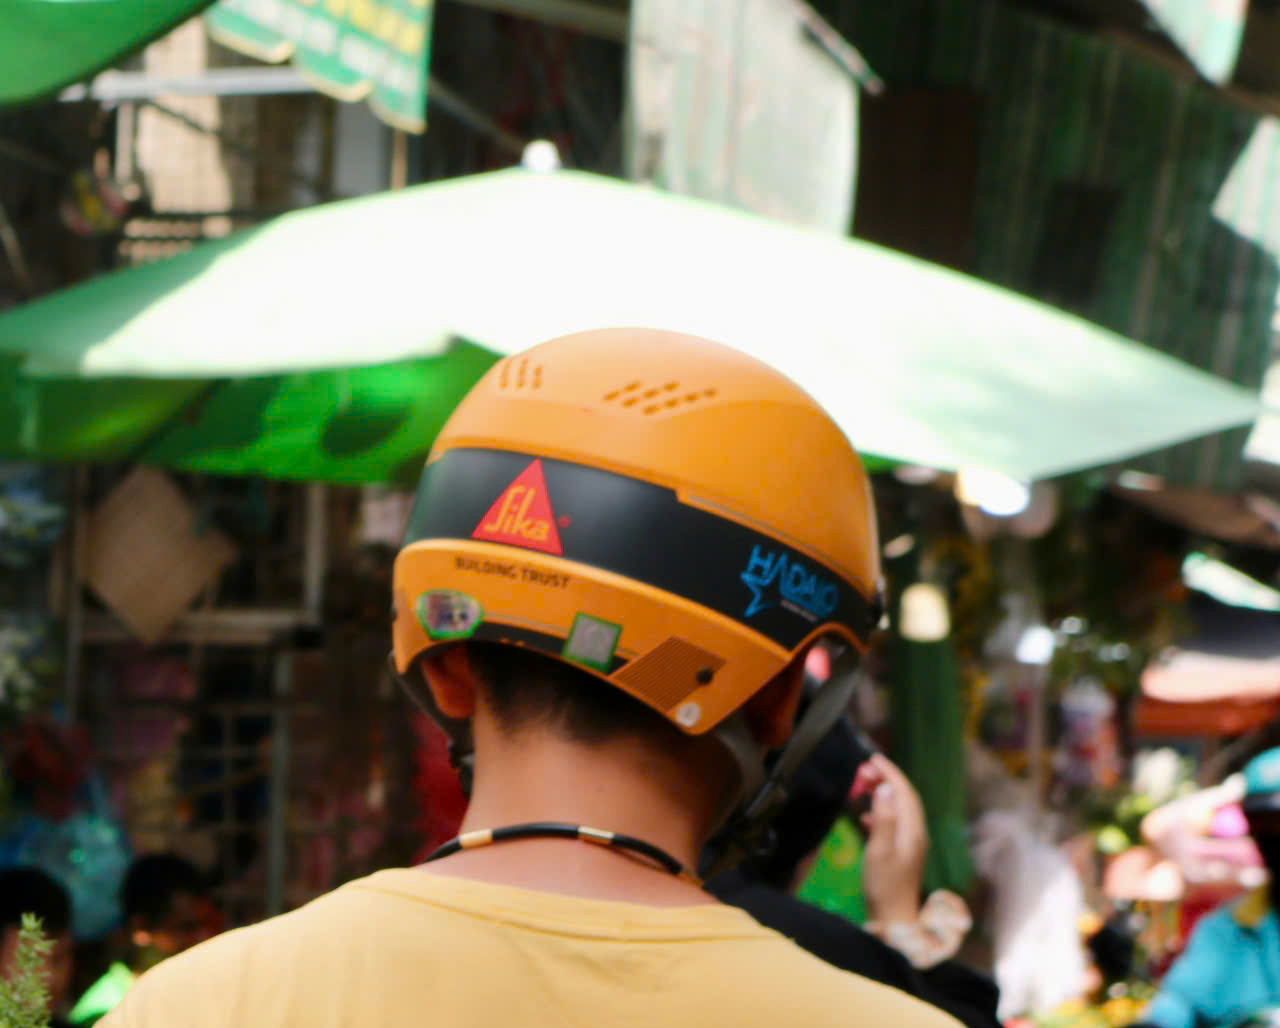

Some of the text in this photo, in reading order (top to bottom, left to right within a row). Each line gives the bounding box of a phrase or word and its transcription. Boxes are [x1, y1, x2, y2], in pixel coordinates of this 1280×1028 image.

[483, 484, 549, 541] Sika
[454, 556, 570, 590] BUILDING TRUST
